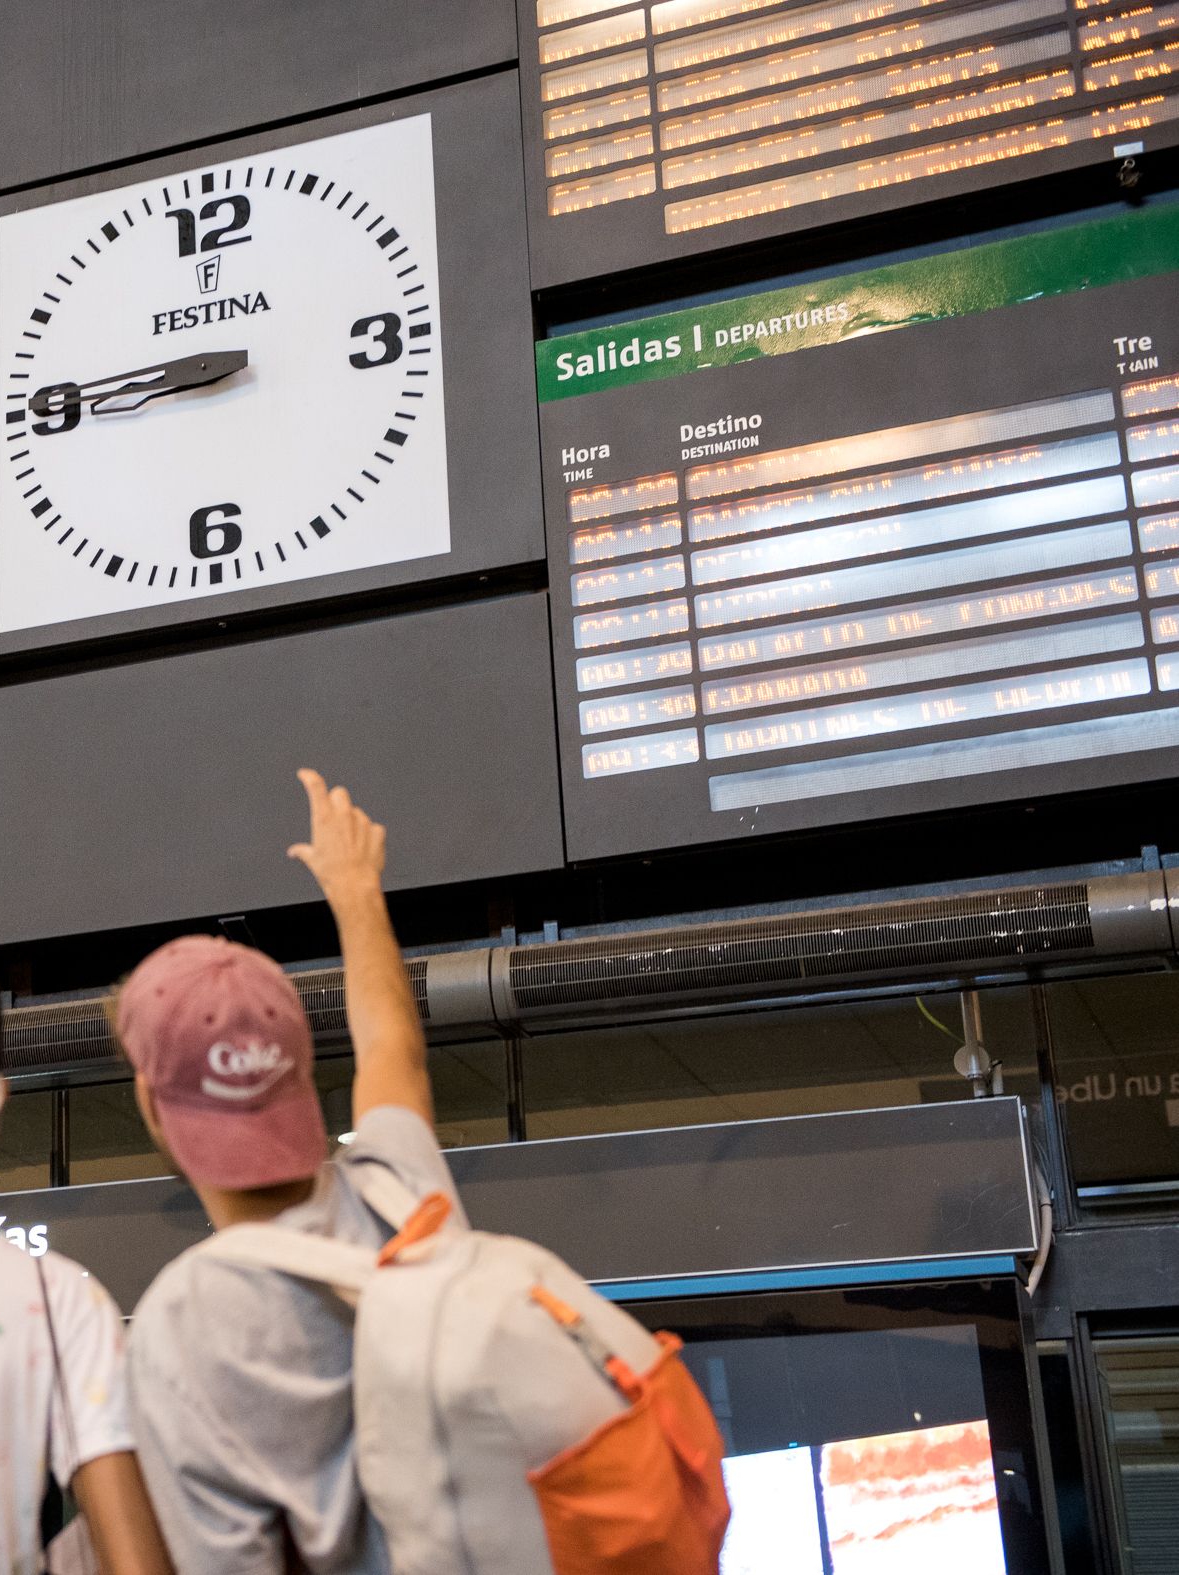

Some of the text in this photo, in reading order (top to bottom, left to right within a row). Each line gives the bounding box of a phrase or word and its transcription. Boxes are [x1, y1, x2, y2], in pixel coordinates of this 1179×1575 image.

[165, 193, 252, 259] 12
[152, 290, 271, 336] FESTINA
[348, 311, 403, 370] 3
[556, 301, 850, 382] Salidas DEPARTURES
[31, 381, 82, 437] 9
[680, 413, 763, 443] Destino
[561, 443, 611, 467] Hora
[681, 435, 760, 461] DESTINATION
[564, 468, 594, 484] TIME
[189, 502, 243, 560] 6
